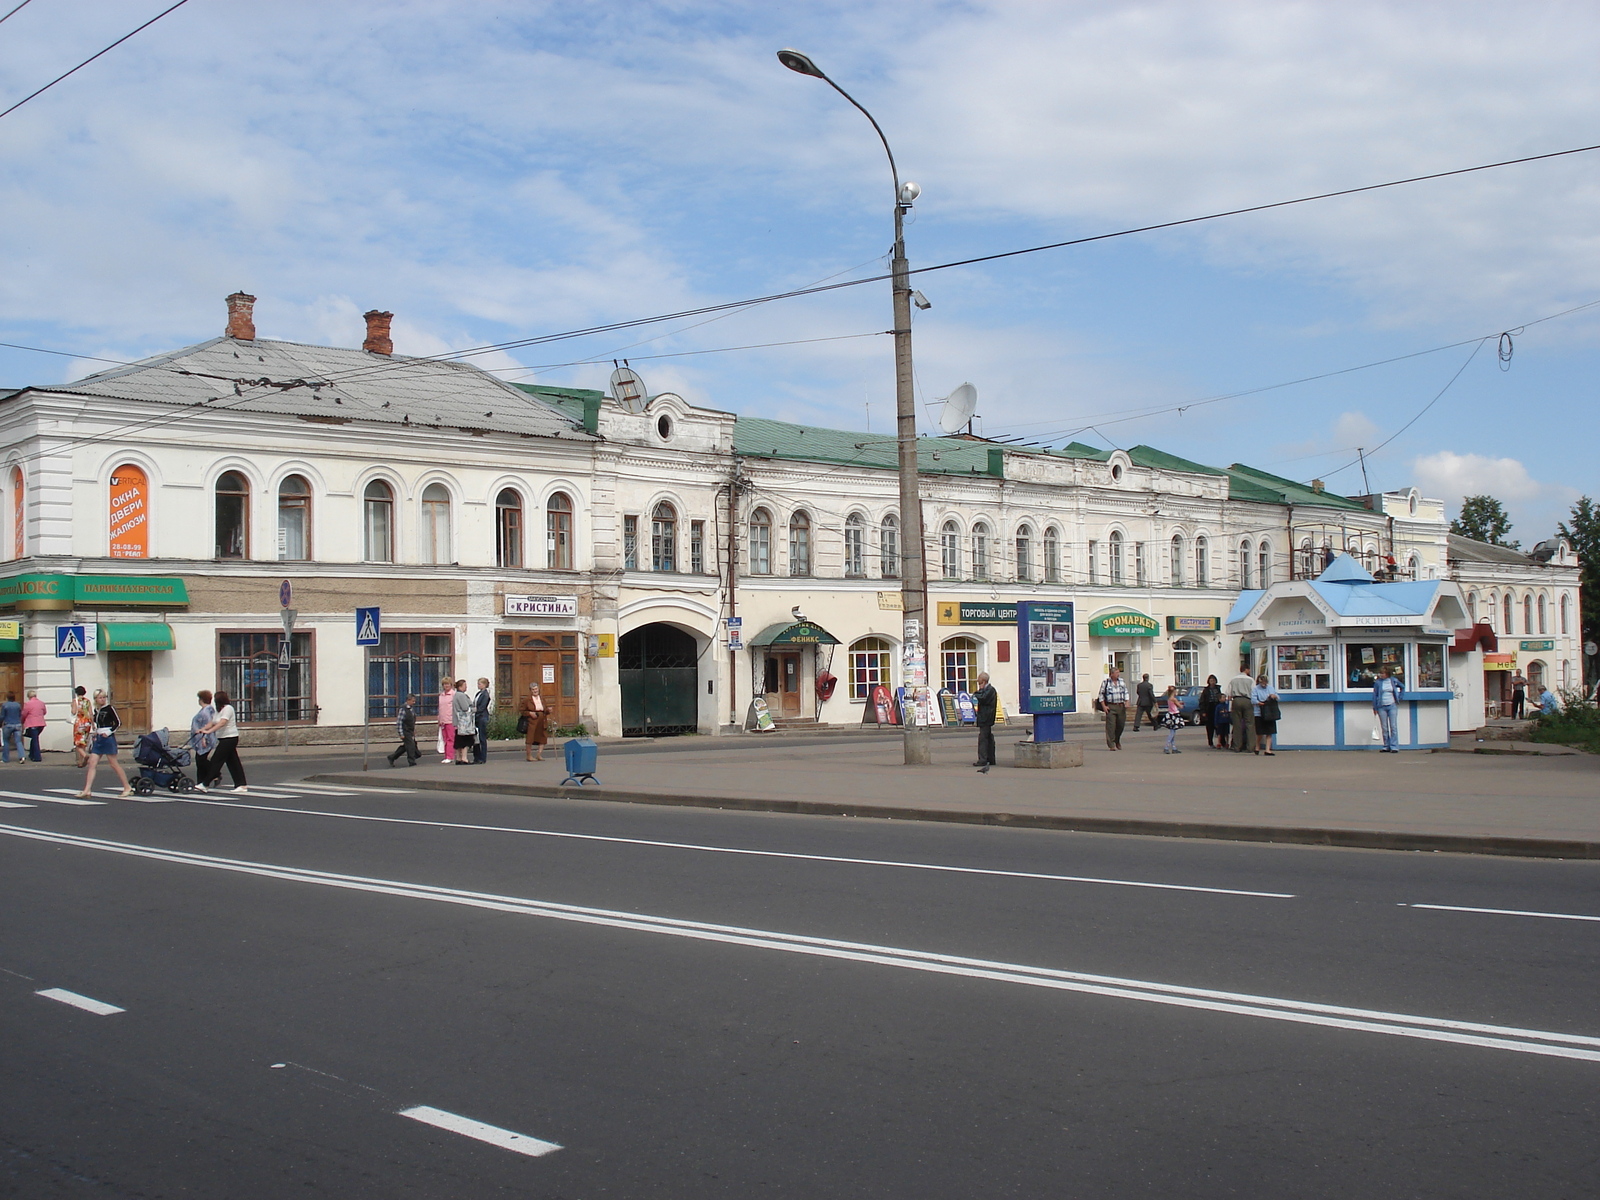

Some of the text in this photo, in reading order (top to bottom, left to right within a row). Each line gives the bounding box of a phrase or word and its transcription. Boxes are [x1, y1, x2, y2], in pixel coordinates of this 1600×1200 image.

[111, 477, 146, 486] VERTICAL
[112, 487, 140, 508] ОКНА
[111, 499, 143, 526] ДВЕРИ
[110, 513, 146, 541] ЖАЛЮЗИ
[16, 581, 59, 595] ЛЮКС
[84, 584, 174, 594] ПАРИКМАХЕРСКАЯ
[516, 602, 568, 613] КРИСТИНА
[961, 608, 1018, 619] ТОРГОВЫЙ ЦЕНТР
[1103, 616, 1156, 630] ЗООМАРКЕТ
[1355, 617, 1410, 625] РОСПЕЧАТЬ
